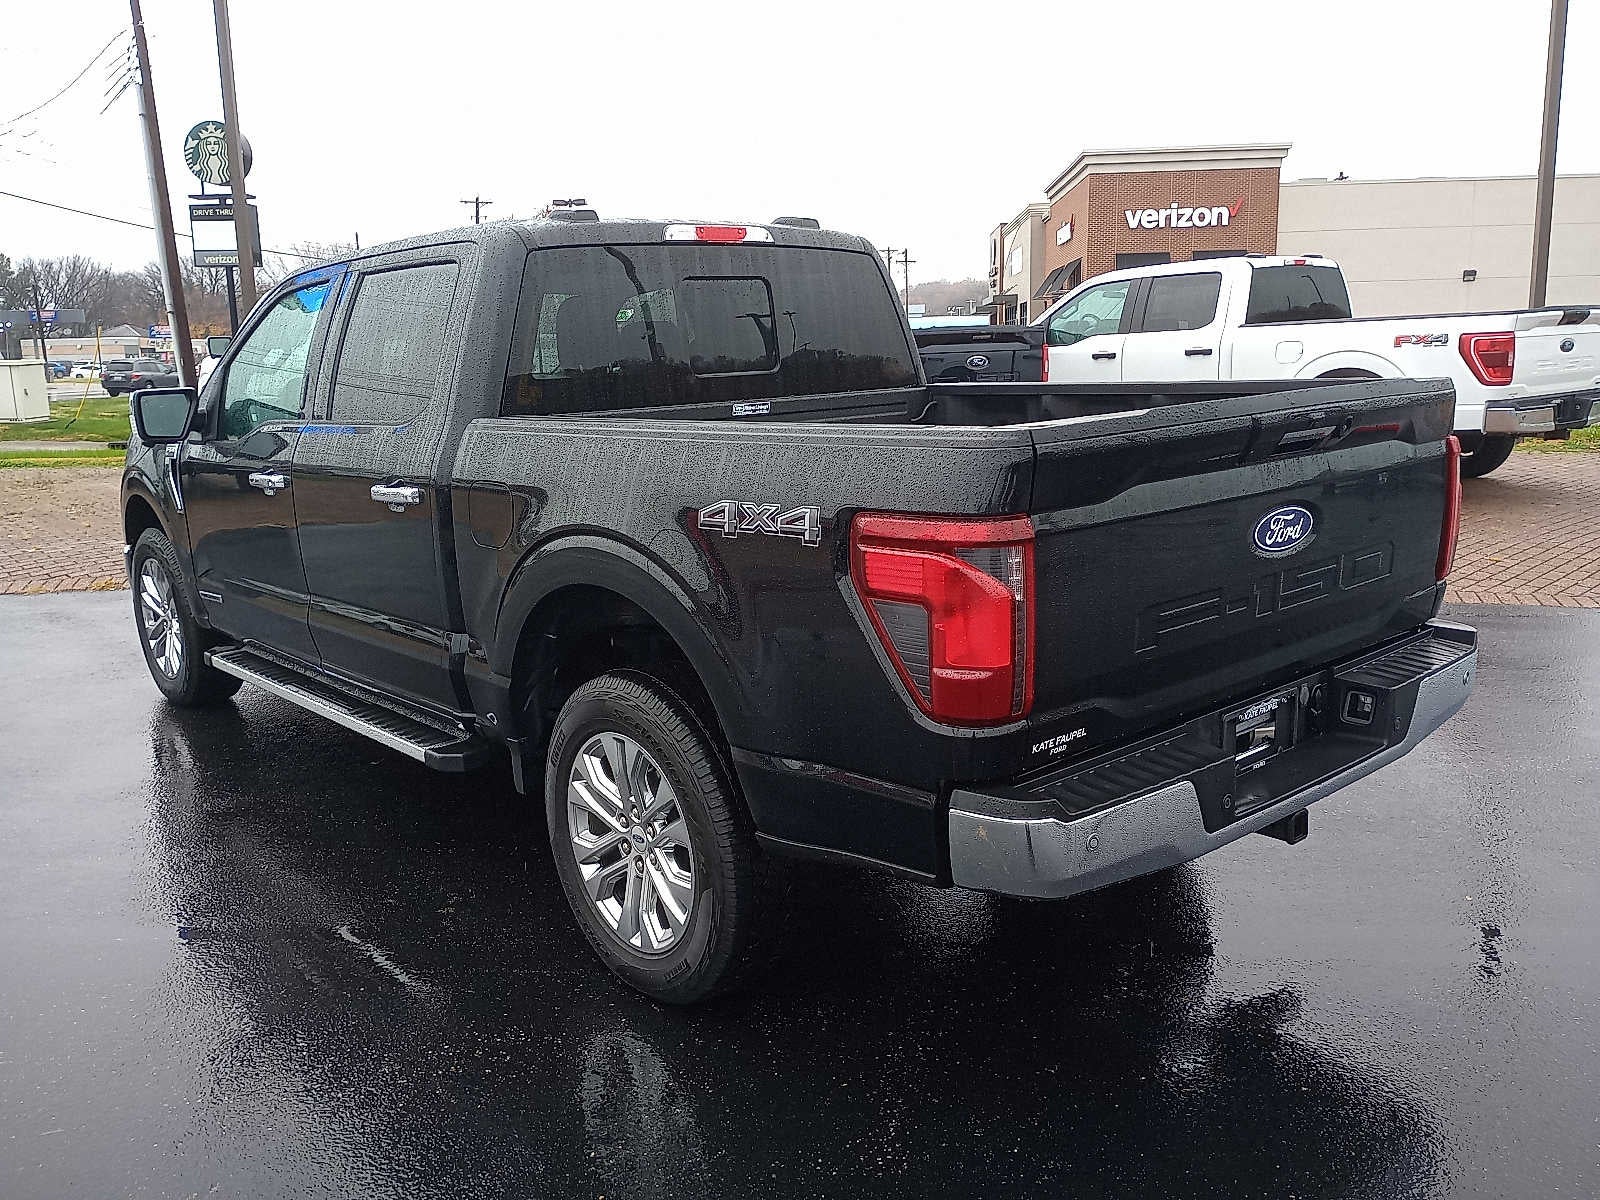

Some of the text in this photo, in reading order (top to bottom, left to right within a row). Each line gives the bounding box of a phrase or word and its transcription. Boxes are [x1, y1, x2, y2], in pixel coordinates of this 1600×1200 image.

[1124, 202, 1230, 229] verizon
[204, 254, 239, 263] verizon
[1393, 333, 1449, 348] FX4
[1264, 511, 1305, 547] Ford
[1135, 541, 1393, 654] F-150
[1032, 727, 1087, 754] KATE FAUPEL
[1049, 744, 1067, 756] FORD
